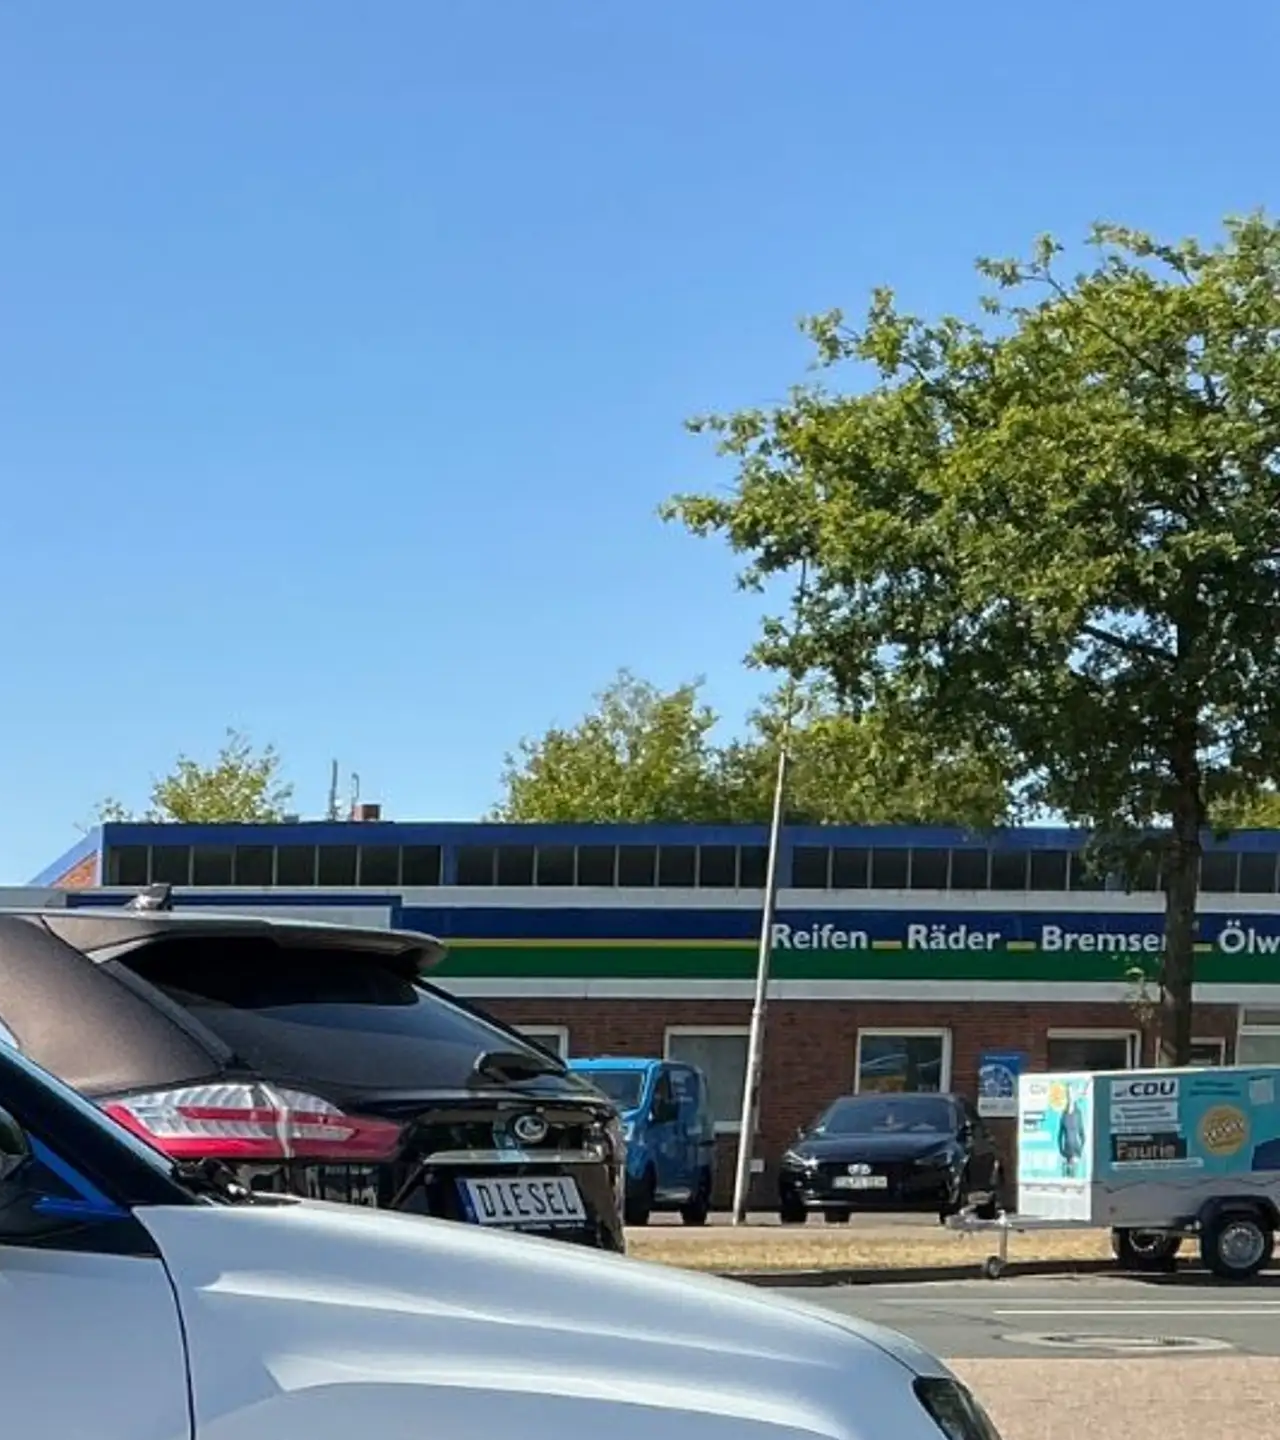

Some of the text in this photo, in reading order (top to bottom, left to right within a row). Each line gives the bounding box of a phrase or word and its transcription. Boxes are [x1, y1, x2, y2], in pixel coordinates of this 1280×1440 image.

[771, 923, 869, 951] Reifen
[907, 923, 1001, 952] Räder
[1041, 924, 1168, 952] Bremse
[1130, 1081, 1176, 1096] CDU
[476, 1182, 578, 1217] DIESEL
